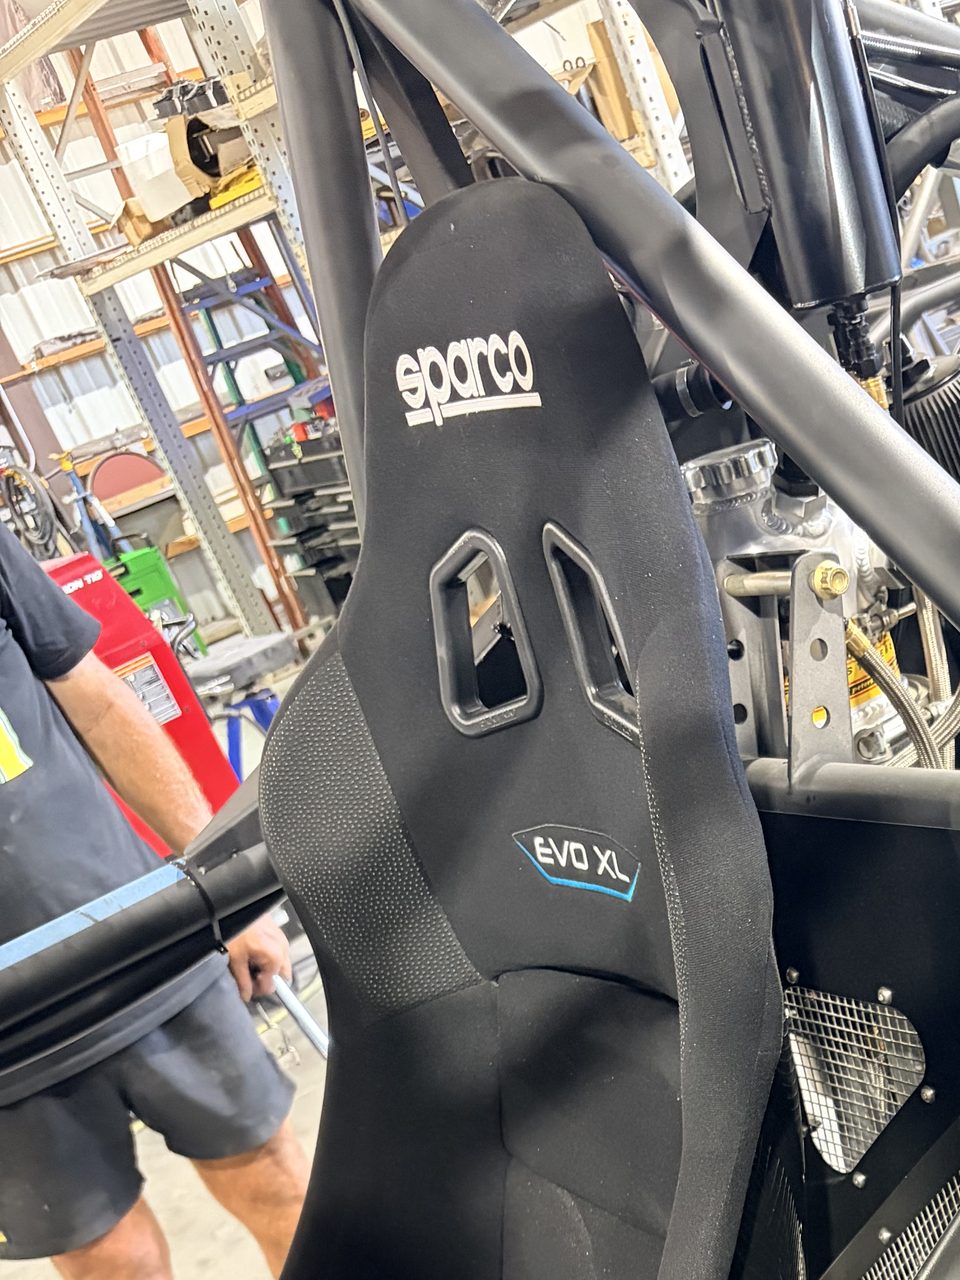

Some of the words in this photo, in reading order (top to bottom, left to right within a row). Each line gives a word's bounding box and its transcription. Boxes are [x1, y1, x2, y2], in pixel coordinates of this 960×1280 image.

[396, 330, 533, 426] sparco
[533, 836, 589, 871] EVO
[592, 845, 631, 883] XL
